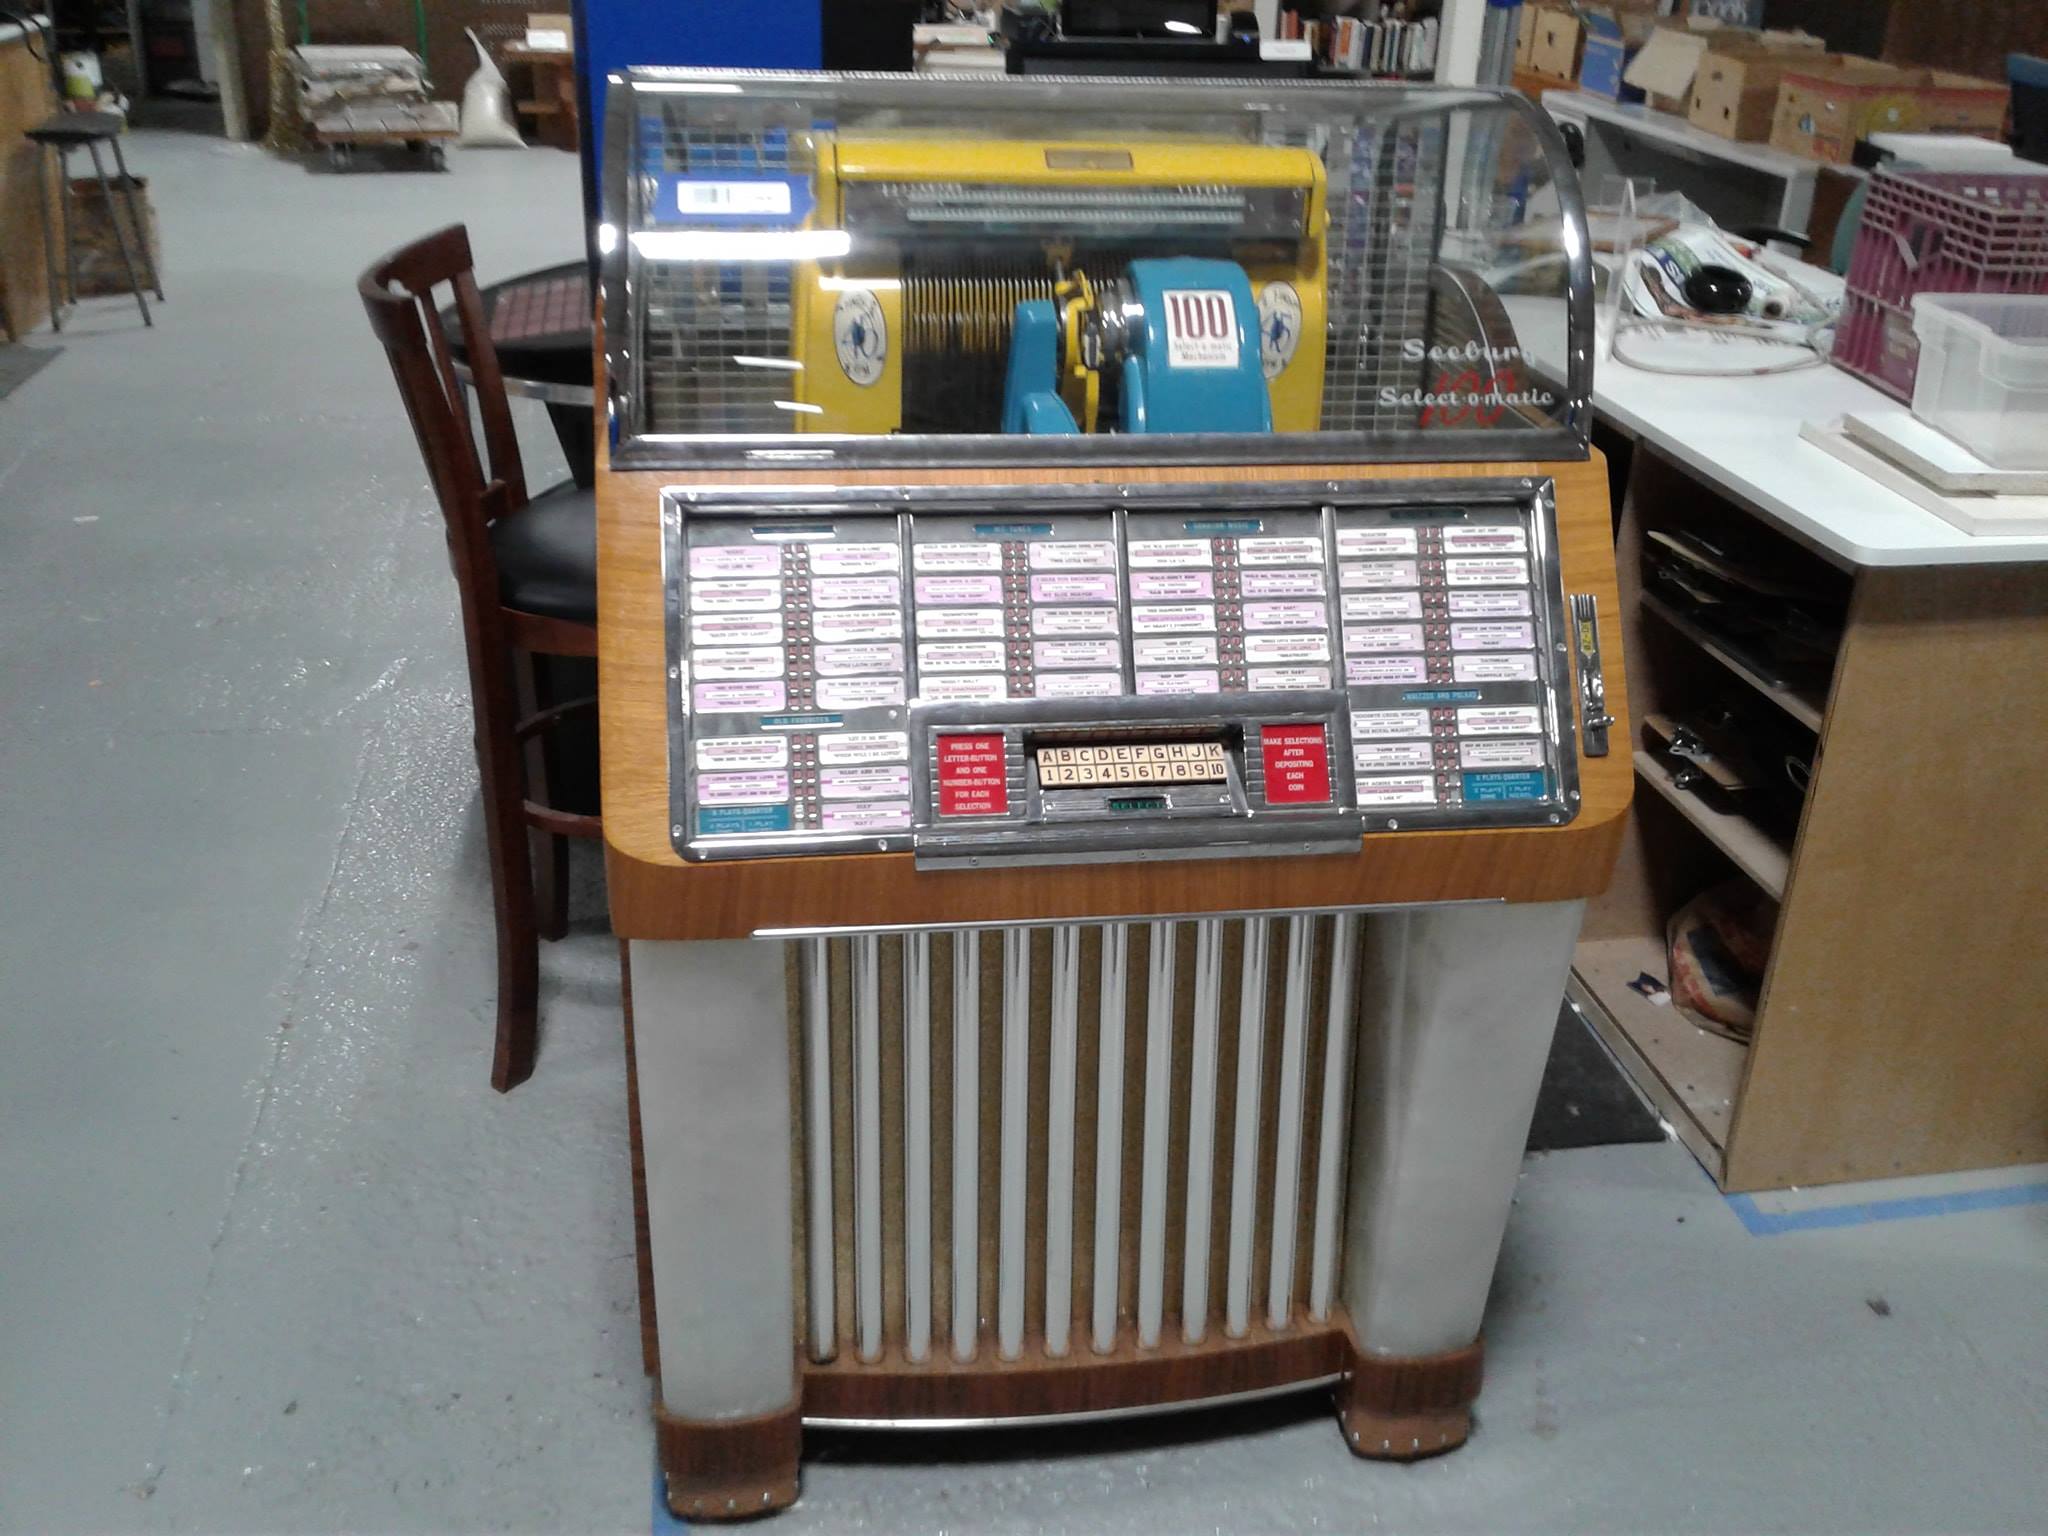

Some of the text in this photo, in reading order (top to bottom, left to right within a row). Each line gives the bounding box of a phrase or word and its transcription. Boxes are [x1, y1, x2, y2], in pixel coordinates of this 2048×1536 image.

[1168, 293, 1229, 338] 100
[1403, 338, 1536, 368] Seeburg
[1263, 736, 1322, 745] MAKE SELECTIONS
[950, 742, 990, 751] PRESS ONE
[1042, 745, 1220, 763] A B C D E F G H J K
[1283, 748, 1304, 757] AFTER
[1274, 760, 1314, 768] DEPOSITING
[972, 766, 988, 774] ONE
[1047, 763, 1224, 781] 1 2 3 4 5 6 7 8 9 10
[1286, 772, 1304, 780] EACH
[1288, 783, 1304, 792] COIN
[971, 790, 990, 798] EACH
[955, 802, 992, 811] SELECTION
